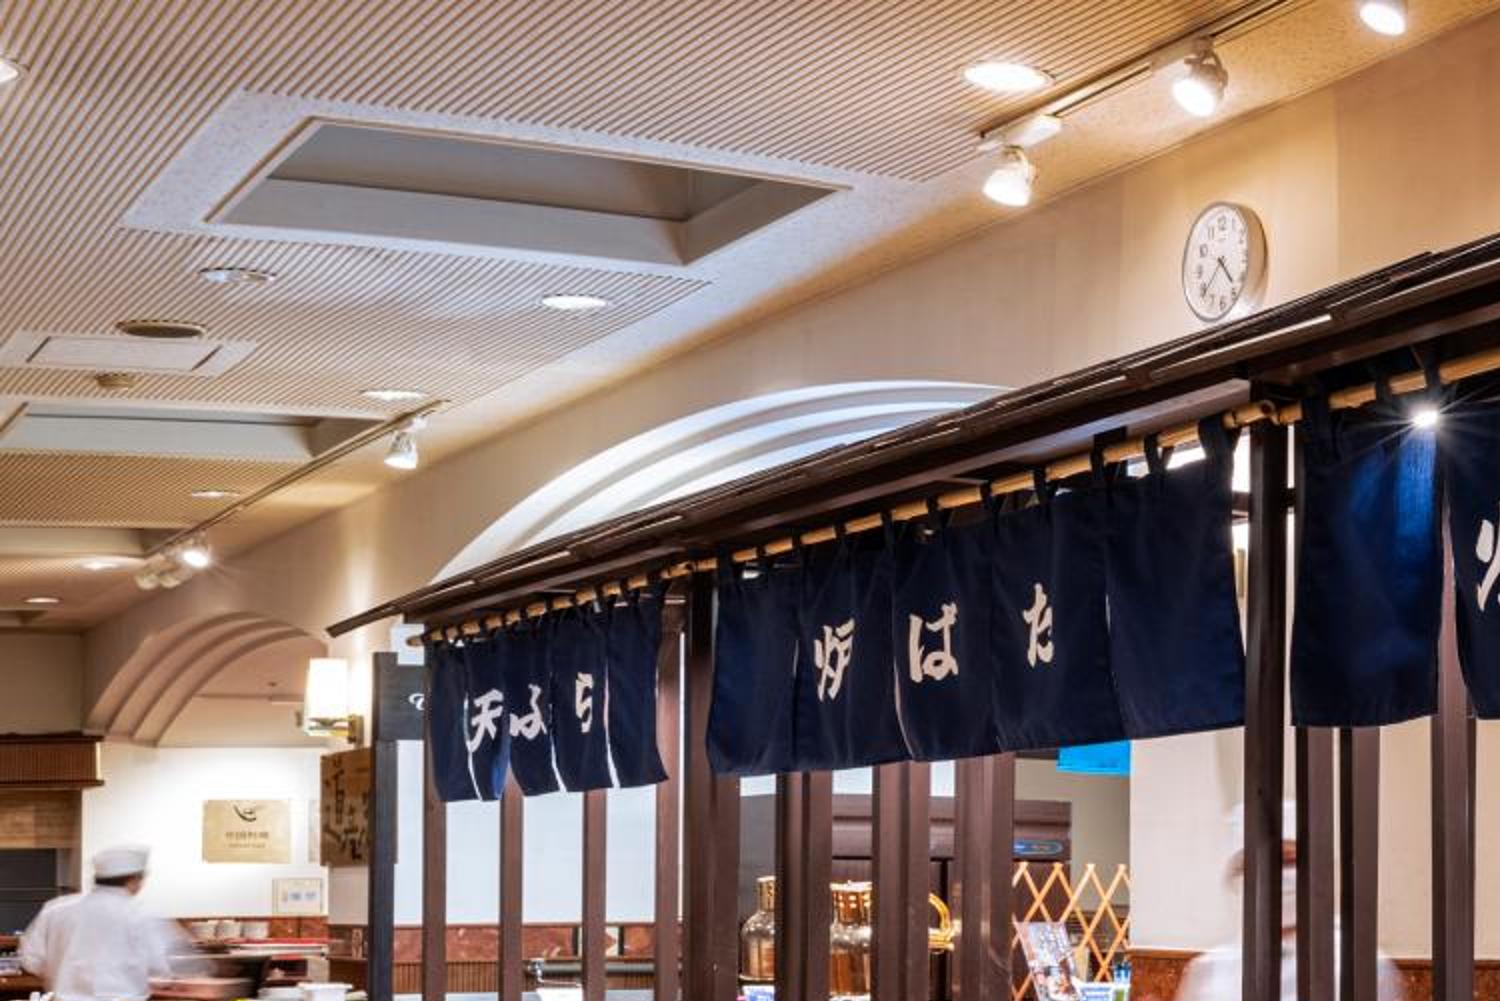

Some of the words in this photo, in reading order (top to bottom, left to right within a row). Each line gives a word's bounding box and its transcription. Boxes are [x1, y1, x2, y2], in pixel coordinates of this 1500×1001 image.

[1217, 215, 1227, 231] 12
[1207, 226, 1215, 241] 11
[814, 583, 1054, 701] 炉ばた
